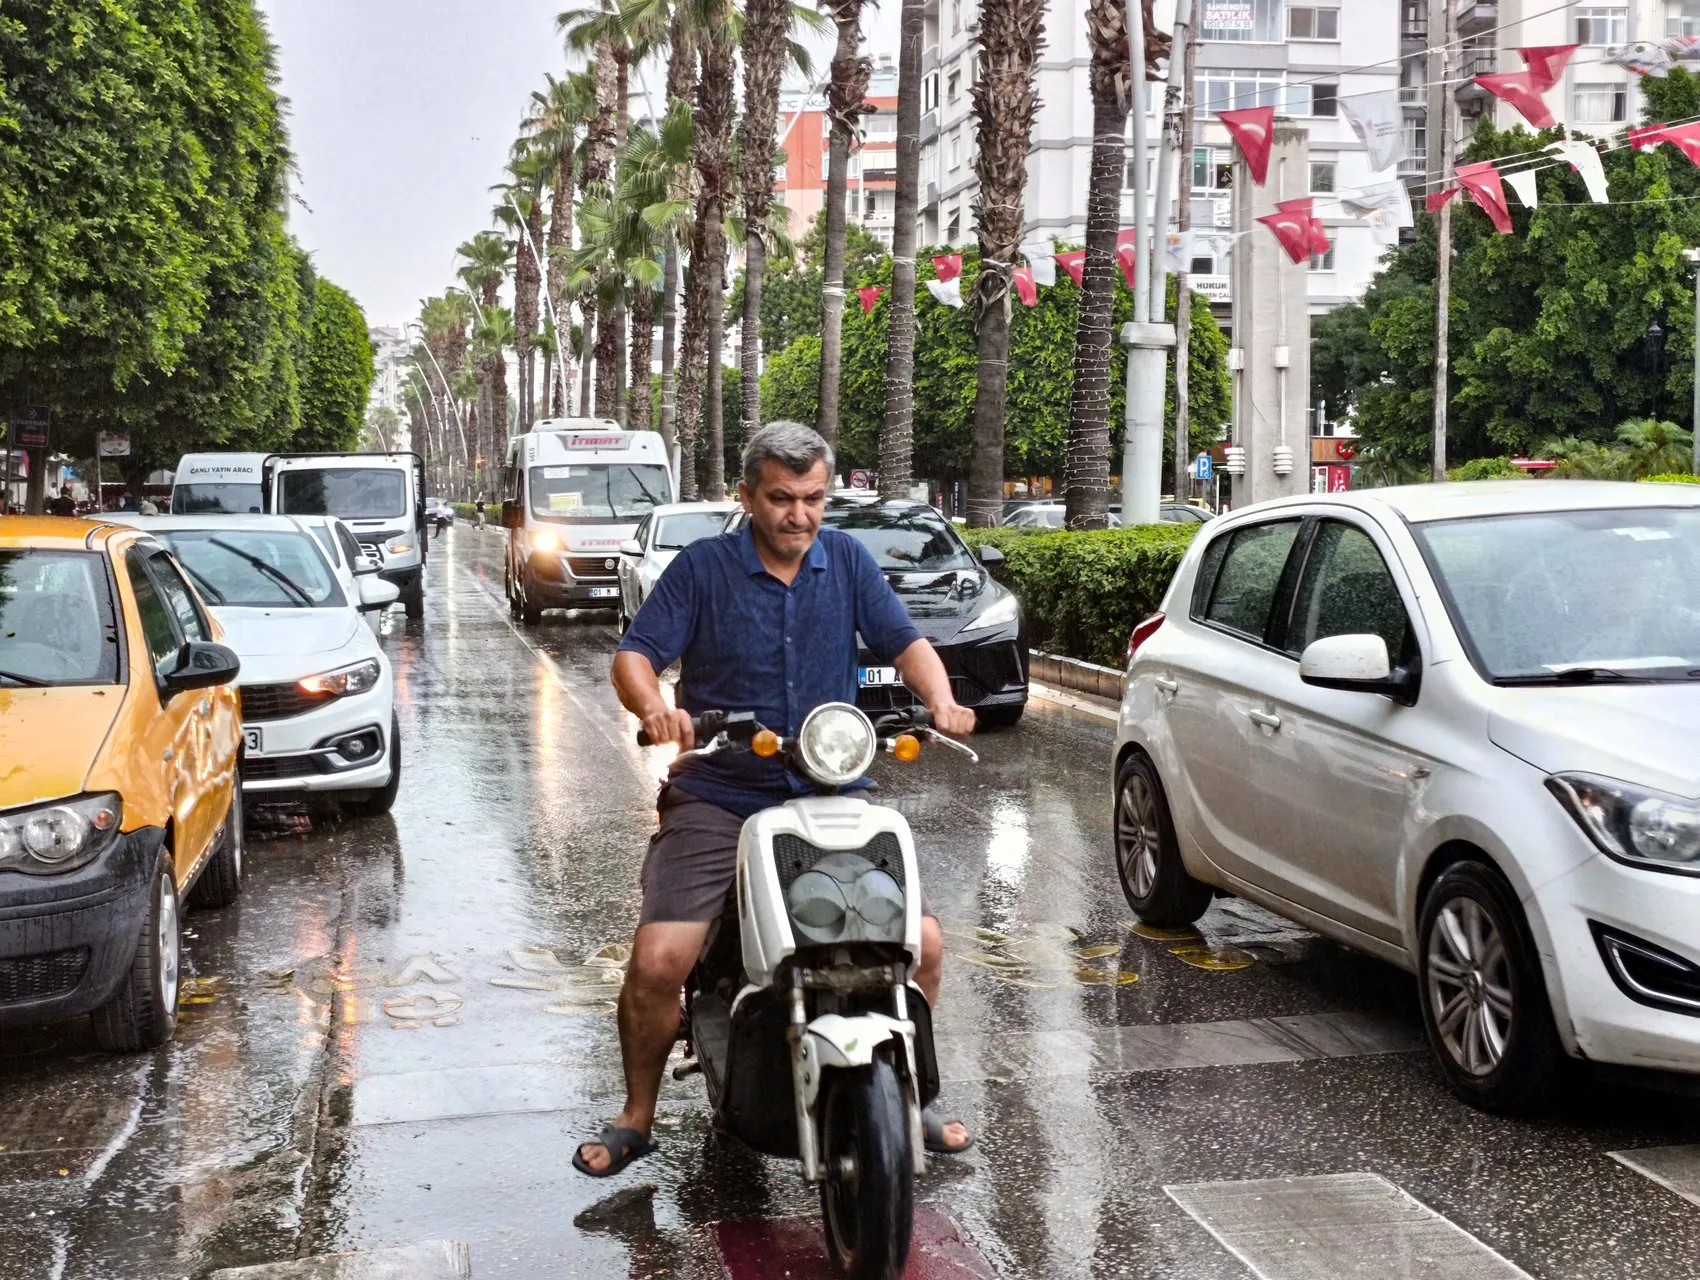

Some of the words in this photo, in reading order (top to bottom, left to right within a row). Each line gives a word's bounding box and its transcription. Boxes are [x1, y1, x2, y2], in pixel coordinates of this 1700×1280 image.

[1199, 457, 1210, 477] P
[593, 588, 601, 596] 01
[867, 669, 882, 683] 01
